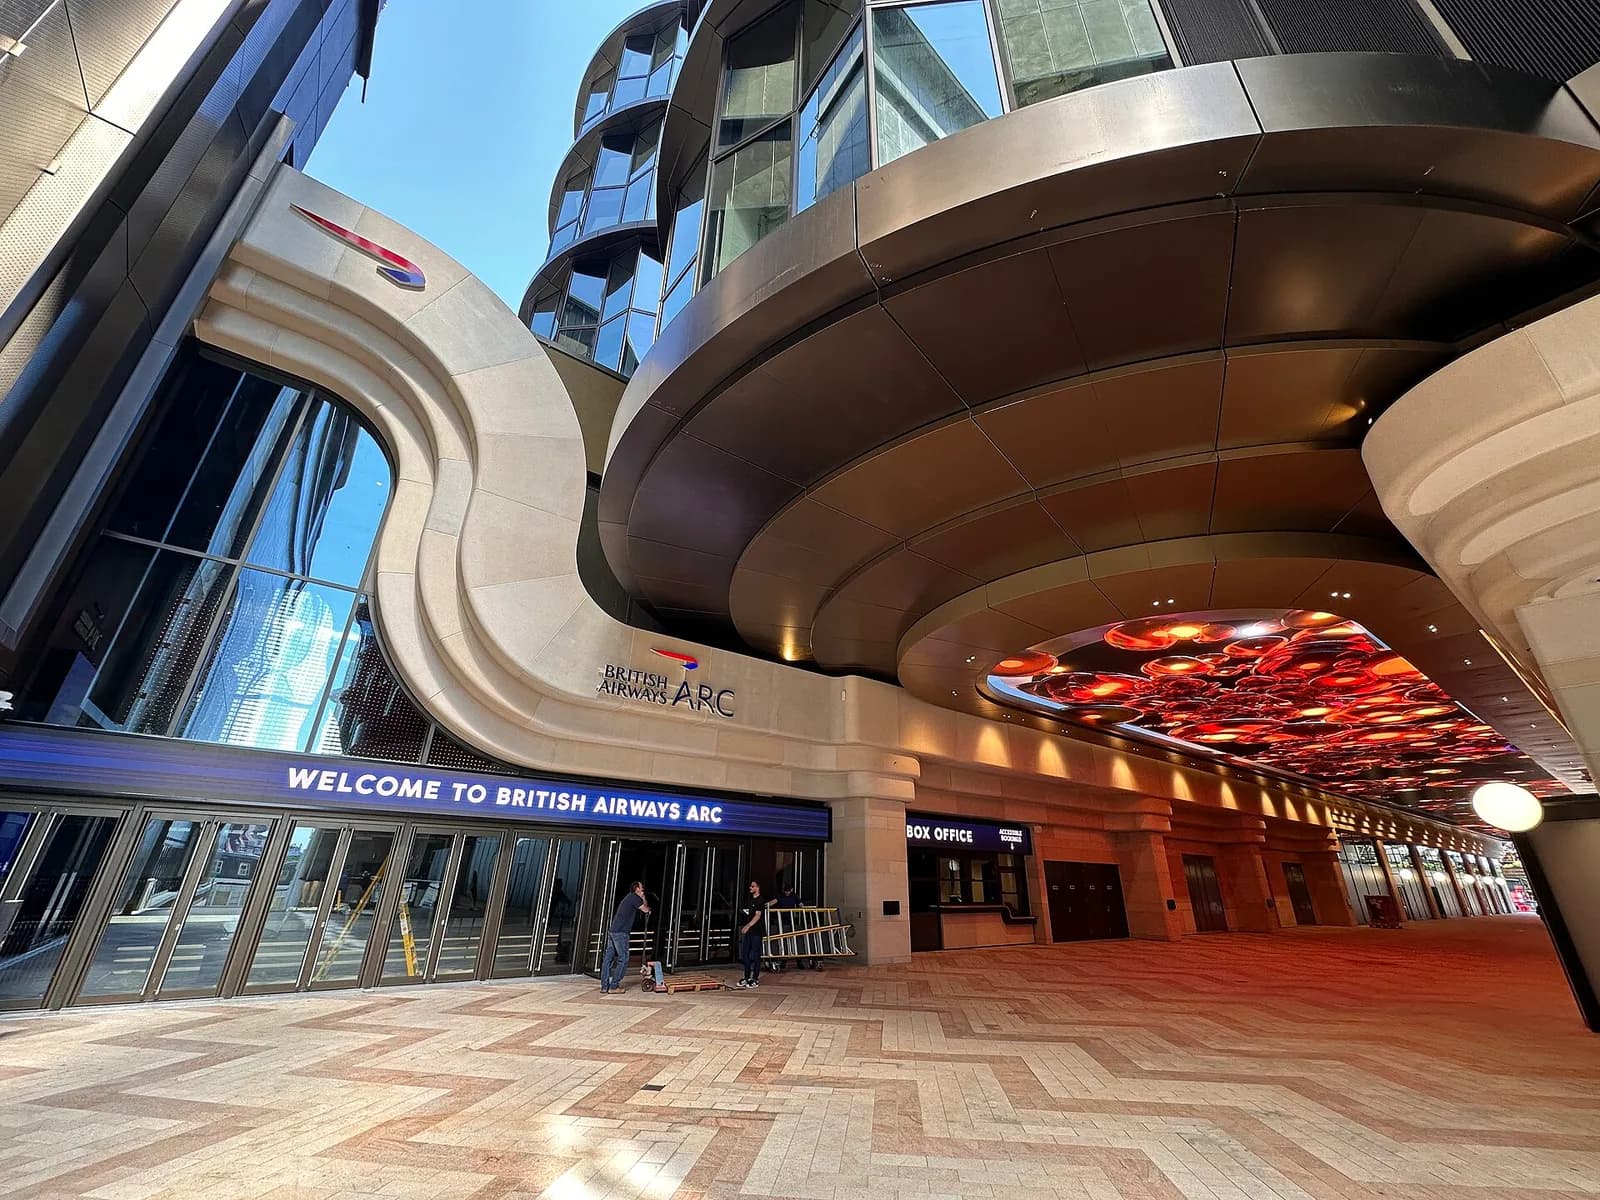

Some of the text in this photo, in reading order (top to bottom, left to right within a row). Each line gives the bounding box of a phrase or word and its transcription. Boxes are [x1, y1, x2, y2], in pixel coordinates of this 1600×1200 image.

[604, 664, 668, 690] BRITISH
[598, 679, 667, 705] AIRWAYS
[671, 680, 736, 718] ARC
[288, 767, 723, 823] WELCOME TO BRITISH AIRWAYS ARC
[906, 824, 973, 843] BOX OFFICE
